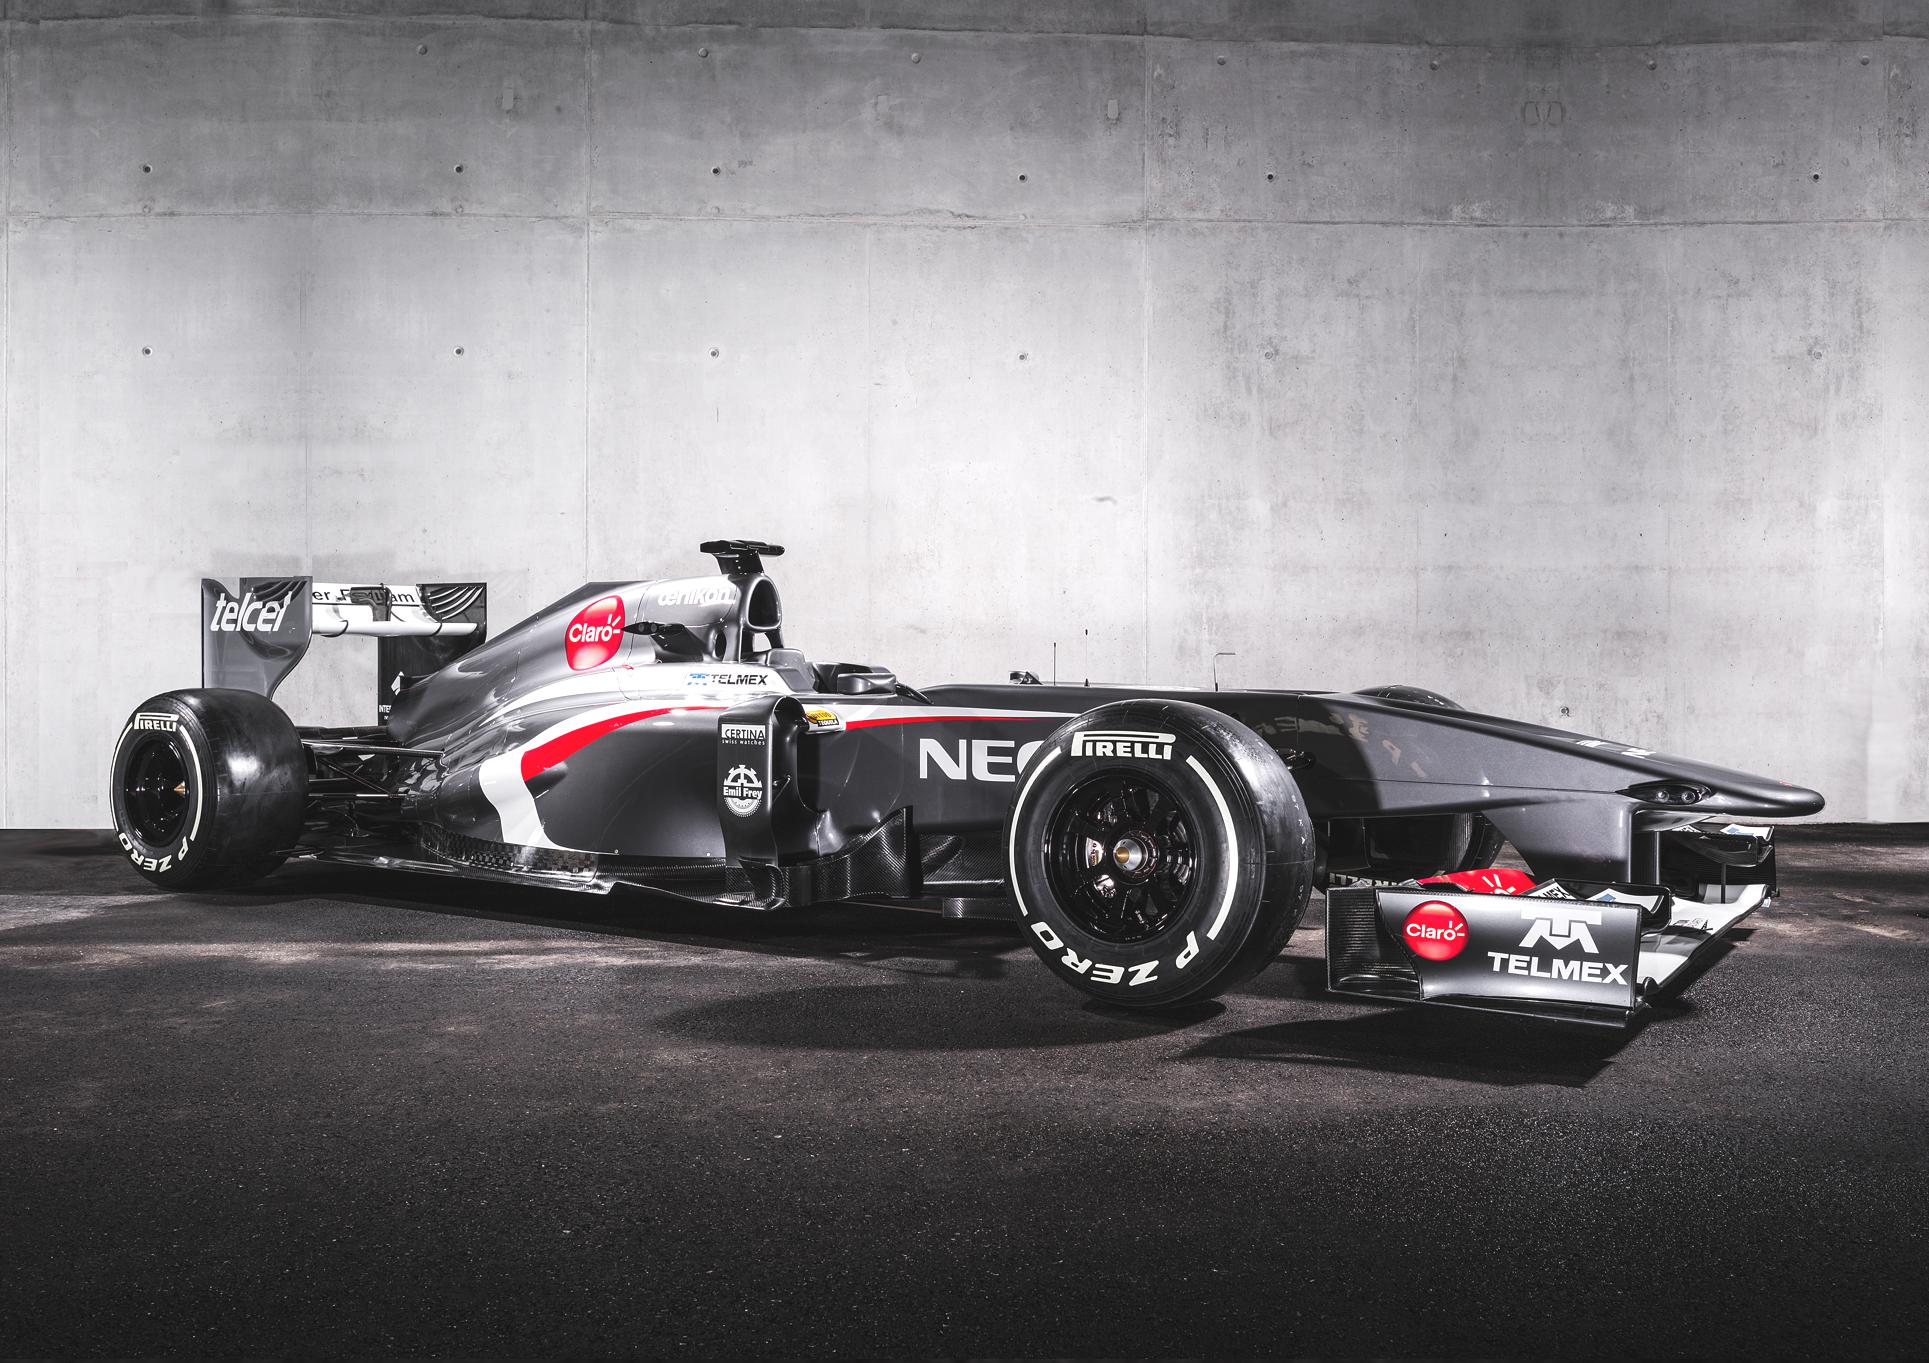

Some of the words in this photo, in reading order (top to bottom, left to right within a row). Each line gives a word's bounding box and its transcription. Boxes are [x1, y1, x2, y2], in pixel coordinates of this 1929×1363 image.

[210, 591, 292, 632] telcel
[568, 624, 611, 643] Claro
[710, 674, 768, 685] TELMEX
[134, 712, 180, 732] PIRELLI
[724, 729, 766, 740] CERTINA
[1070, 731, 1177, 760] PIRELLI
[723, 787, 742, 797] Emil
[743, 788, 763, 800] Frey
[118, 832, 173, 873] ZERO
[1406, 923, 1457, 941] Claro
[1030, 920, 1160, 987] ZERO
[1175, 930, 1200, 970] P
[1487, 950, 1629, 985] TELMEX
